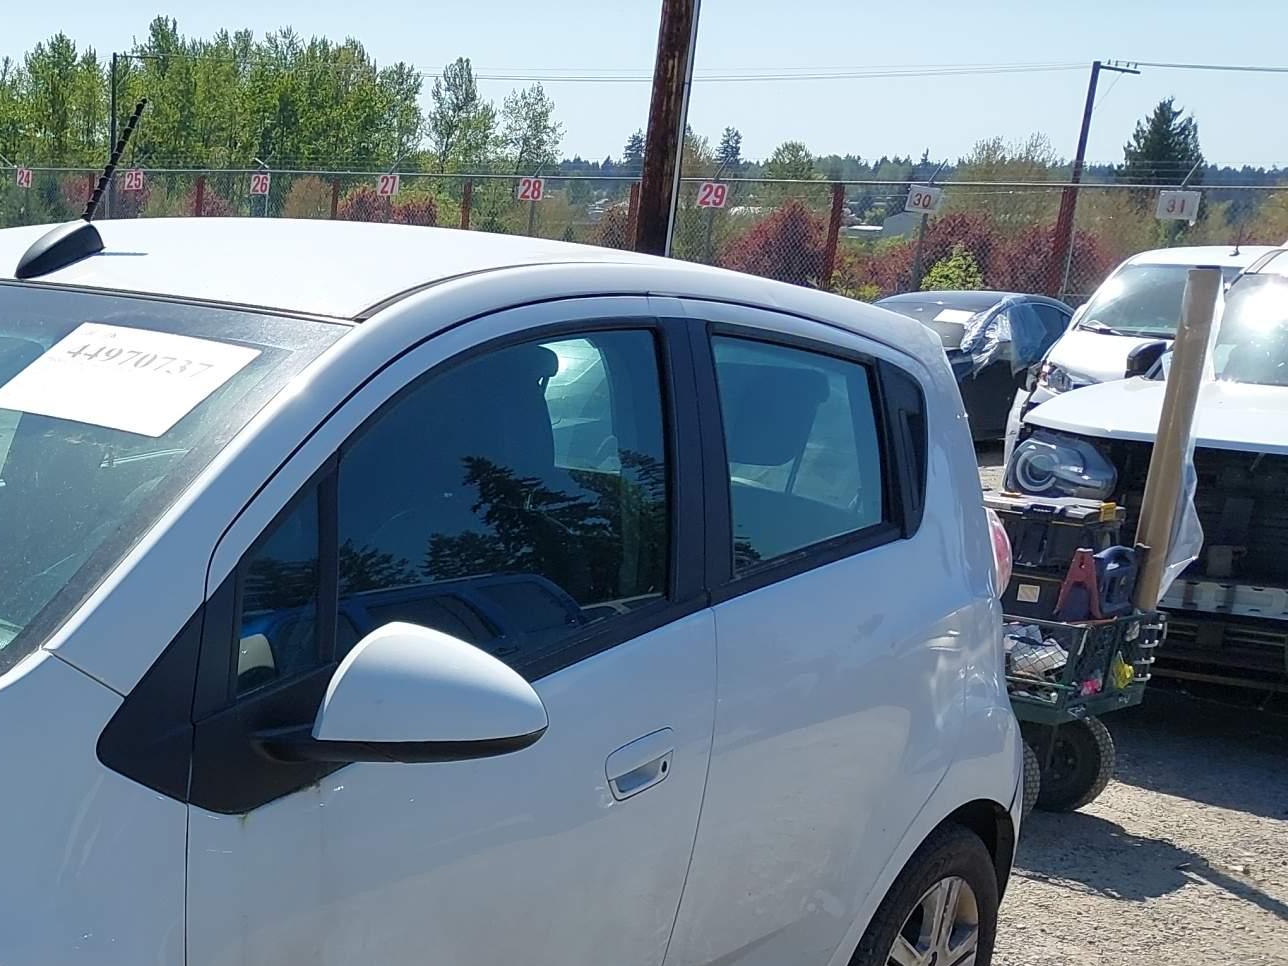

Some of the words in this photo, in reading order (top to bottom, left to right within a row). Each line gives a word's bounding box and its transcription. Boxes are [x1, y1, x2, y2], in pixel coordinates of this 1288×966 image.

[18, 170, 30, 186] 24
[126, 172, 142, 188] 25
[252, 176, 268, 192] 26
[379, 176, 397, 195] 27
[520, 180, 542, 200] 28
[699, 185, 727, 206] 29
[912, 193, 931, 208] 30
[1166, 198, 1186, 213] 31
[67, 343, 214, 378] 44970737
